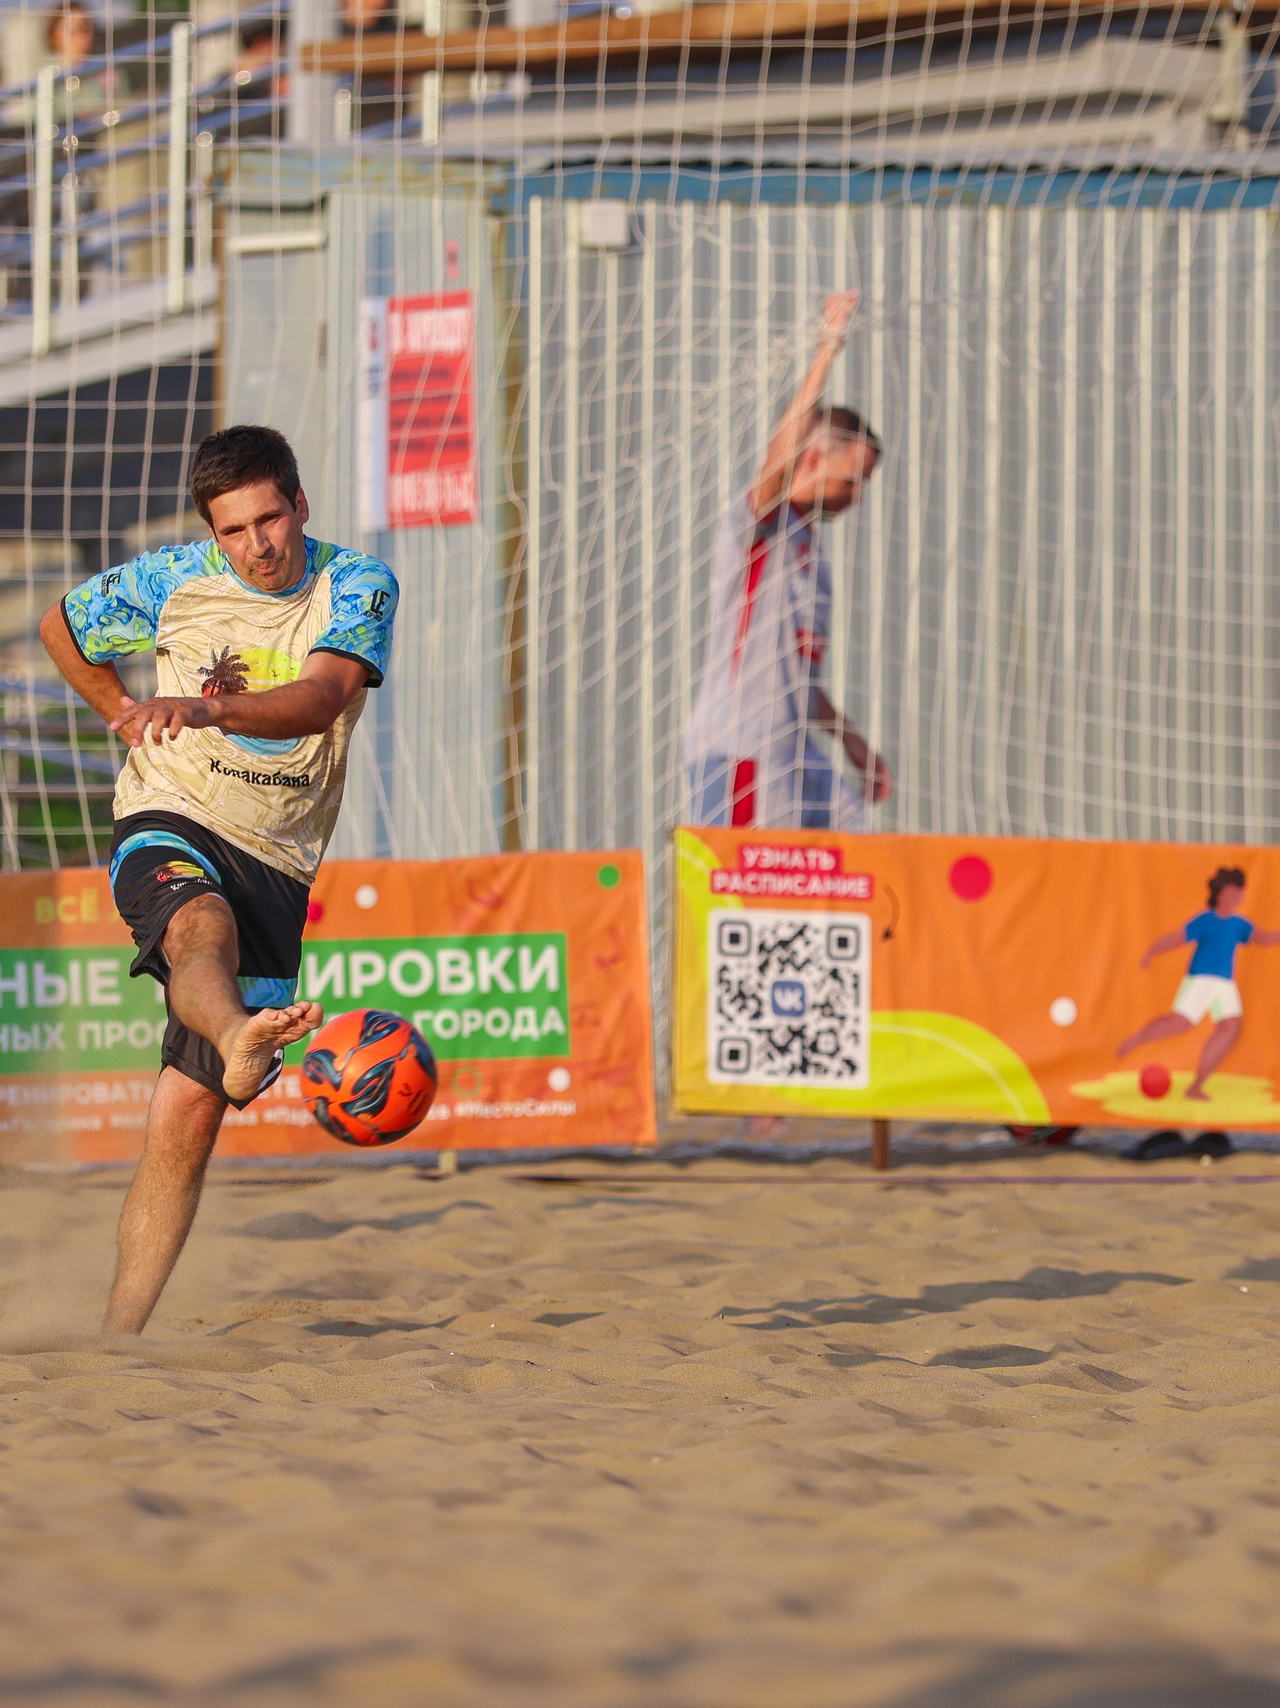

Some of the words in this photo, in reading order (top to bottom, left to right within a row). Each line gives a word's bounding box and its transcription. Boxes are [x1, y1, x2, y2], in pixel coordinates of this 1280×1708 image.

[209, 757, 310, 787] Копакабана
[741, 847, 836, 871] УЗНАТЬ
[712, 870, 871, 898] РАСПИСАНИЕ
[412, 1005, 567, 1042] ГОРОДА
